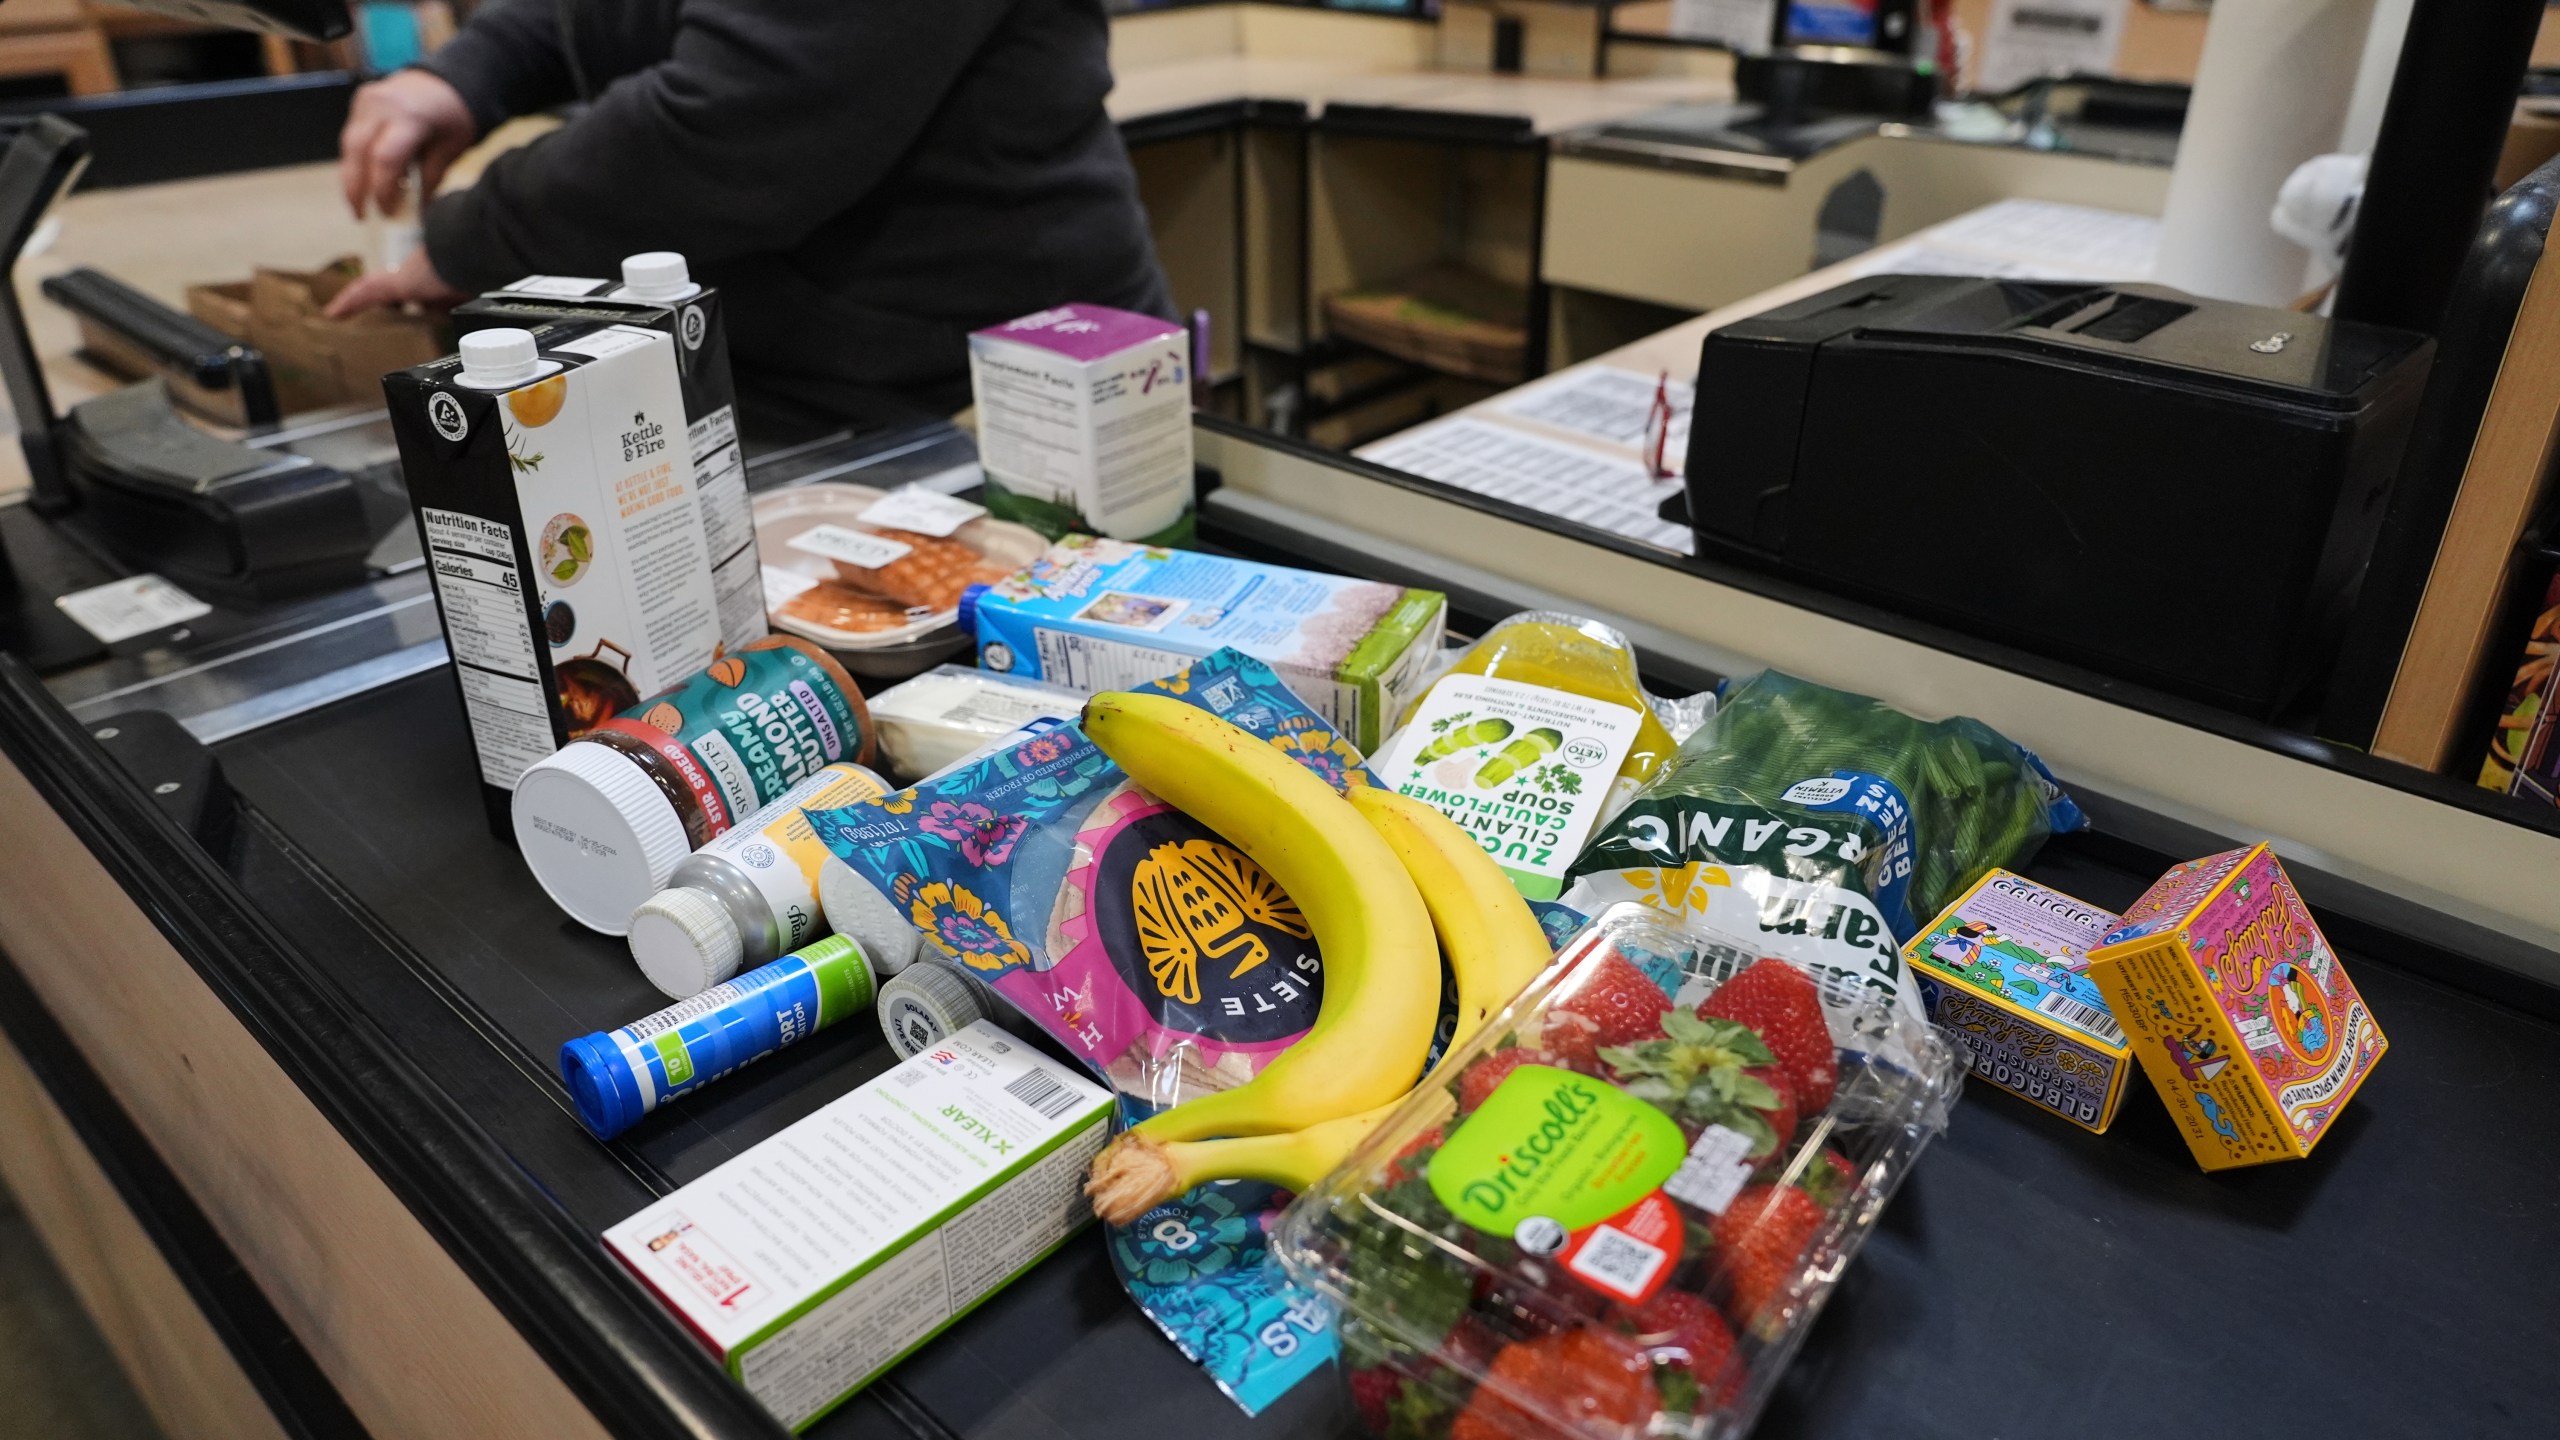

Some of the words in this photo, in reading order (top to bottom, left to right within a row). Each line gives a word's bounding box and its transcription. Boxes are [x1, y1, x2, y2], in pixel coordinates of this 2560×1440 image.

[621, 422, 663, 449] Kettle
[624, 448, 633, 462] &
[635, 438, 665, 459] Fire
[426, 511, 478, 532] Nutrition
[480, 521, 509, 540] Facts
[430, 535, 452, 548] Serving
[454, 540, 465, 548] size
[485, 547, 495, 557] cup
[435, 559, 474, 577] Calories
[502, 571, 518, 588] 45
[1453, 691, 1472, 700] ELSE
[1474, 695, 1517, 708] NOTHING
[770, 689, 824, 776] BUTTER
[799, 689, 837, 750] UNSALTED
[1486, 705, 1571, 728] NUTRIENT-DENSE
[1525, 706, 1588, 725] INGREDIENTS
[1590, 719, 1616, 731] REAL
[663, 744, 705, 790] SPREAD
[1034, 743, 1098, 778] REFRIGERATED
[1568, 745, 1602, 759] KETO
[701, 741, 749, 815] SPROUTS
[985, 777, 1019, 802] FROZEN
[1019, 773, 1036, 785] OR
[1794, 786, 1844, 794] VITAMIN
[702, 791, 723, 825] STIR
[1399, 783, 1567, 830] CAULIFLOWER
[1502, 790, 1575, 815] SOUP
[840, 822, 886, 843] (198g)
[882, 820, 901, 834] OZ
[1628, 811, 1868, 864] RGANIC
[1856, 794, 1898, 887] GREEN
[1868, 782, 1911, 879] BEANS
[1992, 879, 2099, 930] GALICIA,
[2041, 889, 2106, 918] Greetings
[2150, 899, 2200, 934] TUNA
[2219, 881, 2295, 991] Fishwife
[1219, 953, 1321, 1017] SIETE
[2145, 951, 2169, 985] sustainable
[2153, 949, 2165, 962] From
[2167, 974, 2180, 988] MSC
[2176, 989, 2195, 1014] certified
[904, 1003, 939, 1033] SOLARAY
[1941, 995, 2059, 1059] Fishwife
[2336, 1003, 2372, 1054] ALBACORE
[667, 1057, 682, 1076] 10
[951, 1039, 999, 1068] XLEAR.COM
[2332, 1047, 2353, 1078] TUNA
[1996, 1048, 2075, 1095] SPANISH
[2310, 1070, 2334, 1105] SPICY
[2328, 1068, 2340, 1086] IN
[2164, 1078, 2206, 1139] 04/30/2031
[2218, 1079, 2245, 1117] Reproductive
[2241, 1118, 2257, 1137] Harm
[2230, 1083, 2255, 1117] WARNING:
[2280, 1090, 2294, 1111] OIL
[2289, 1075, 2313, 1111] OLIVE
[937, 1103, 999, 1144] XLEAR
[2239, 1074, 2265, 1108] Refrigerate
[2260, 1109, 2274, 1124] After
[2268, 1125, 2290, 1152] Opening
[1461, 1078, 1600, 1217] Driscoll's
[1137, 1205, 1191, 1240] TORTILLAS
[1152, 1217, 1198, 1251] 8
